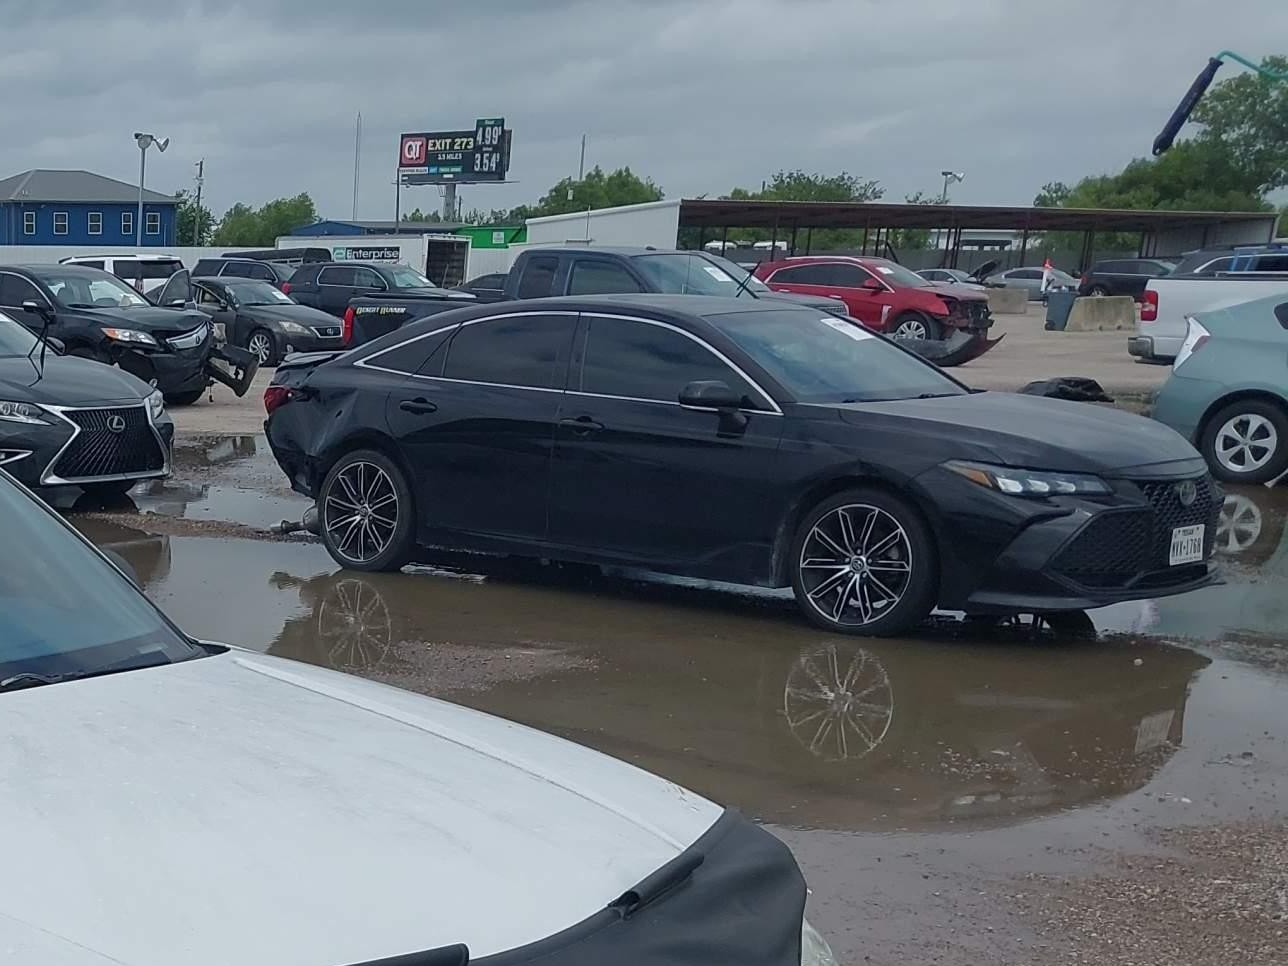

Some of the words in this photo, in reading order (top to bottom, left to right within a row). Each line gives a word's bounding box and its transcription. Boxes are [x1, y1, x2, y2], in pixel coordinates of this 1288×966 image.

[404, 141, 423, 161] QT
[428, 139, 452, 151] EXIT
[454, 138, 474, 150] 273
[346, 247, 399, 260] Enterprise
